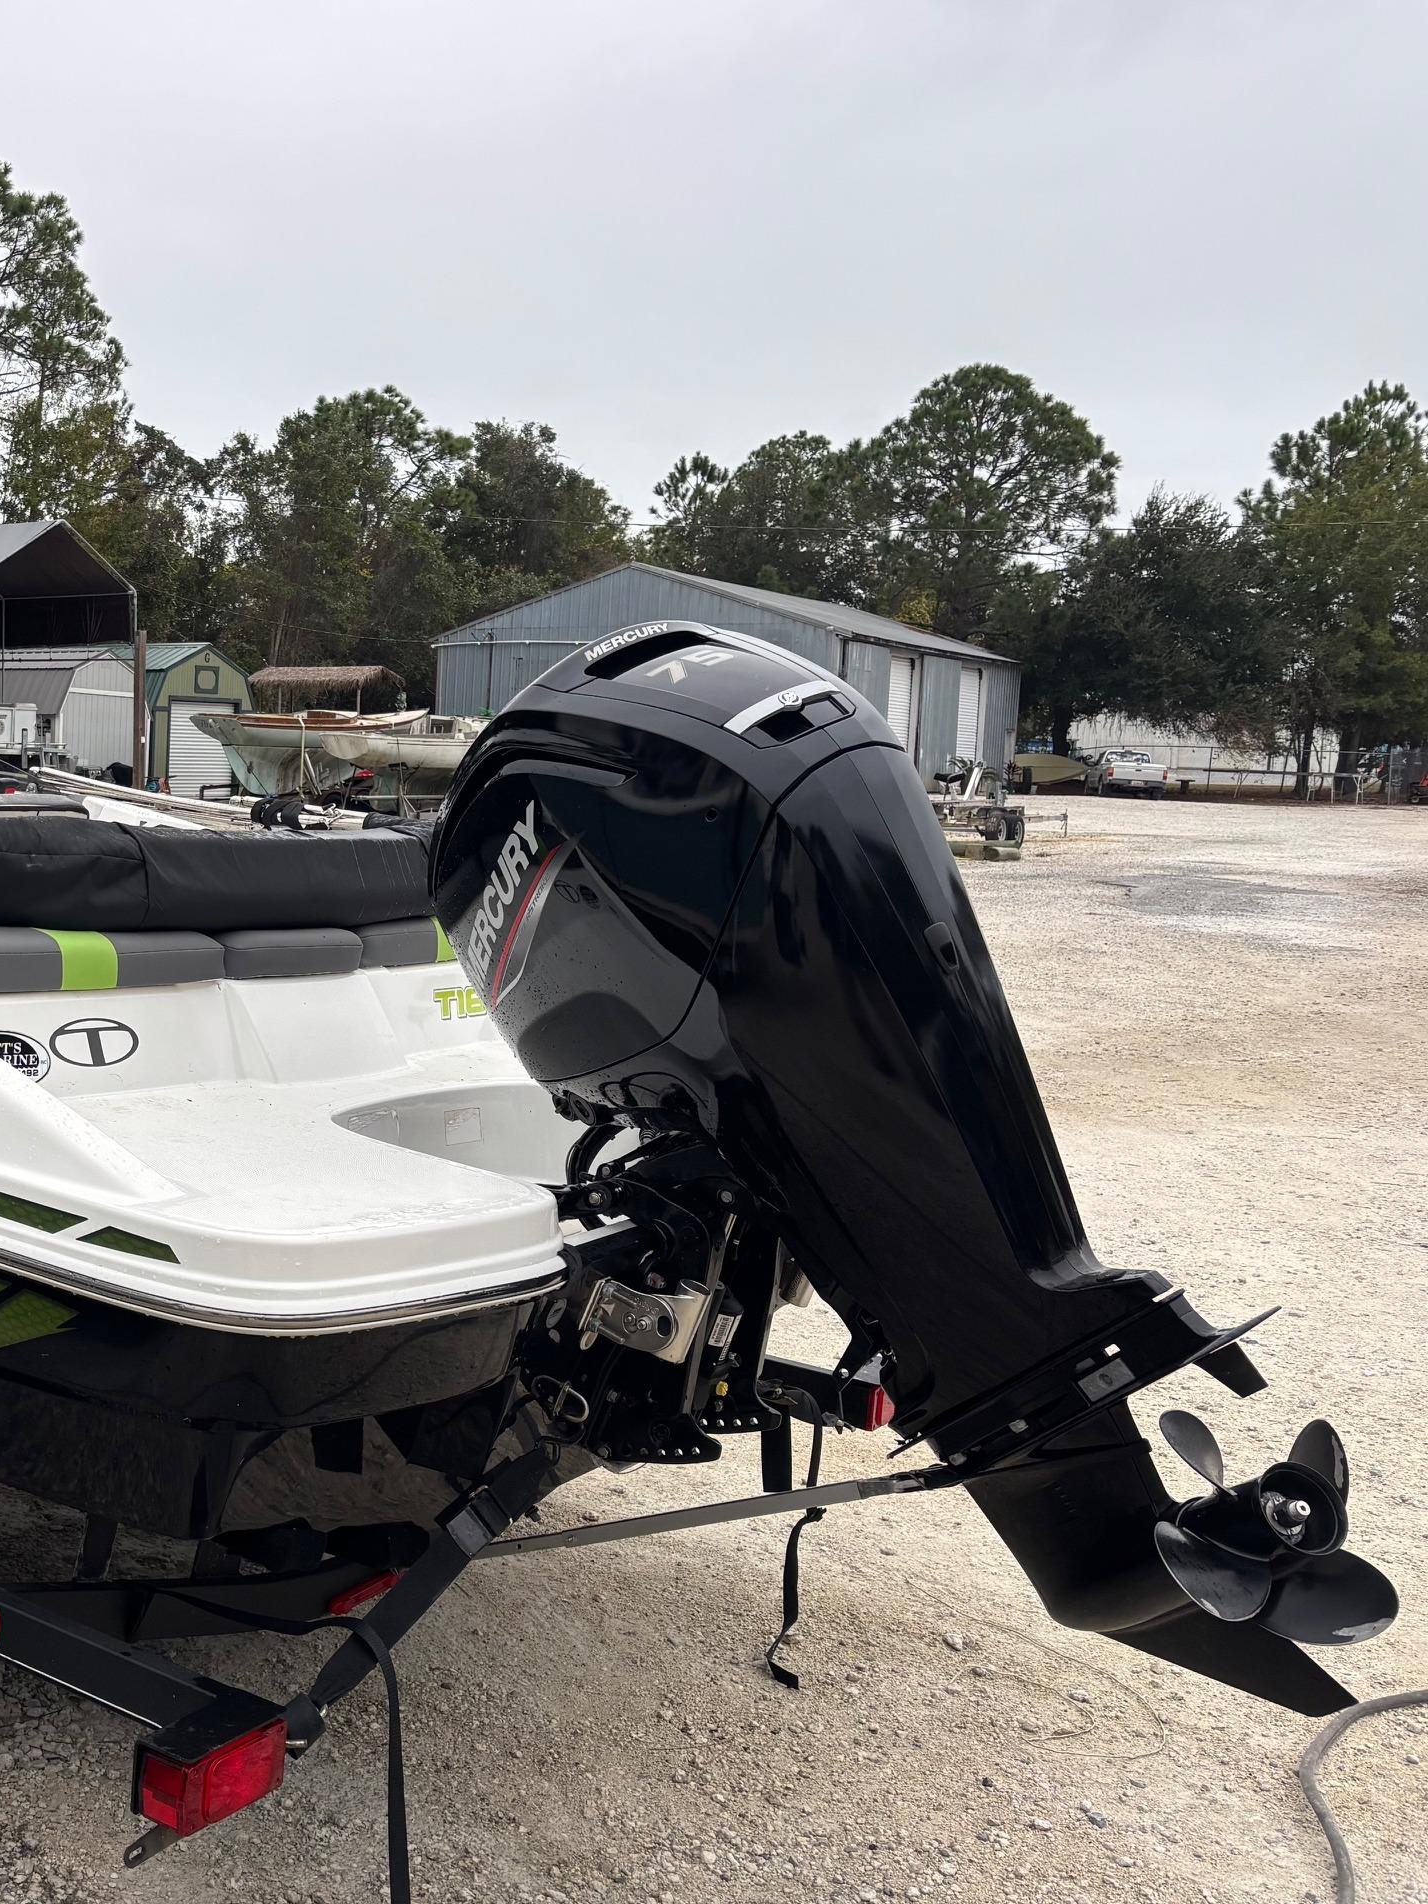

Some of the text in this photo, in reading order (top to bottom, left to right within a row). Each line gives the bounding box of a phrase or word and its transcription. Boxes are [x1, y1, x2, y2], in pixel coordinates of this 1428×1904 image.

[204, 652, 211, 663] G
[584, 623, 669, 662] MERCURY
[644, 649, 734, 684] 75
[465, 800, 539, 991] MERCURY
[433, 986, 487, 1020] T16
[2, 1054, 38, 1066] RINE
